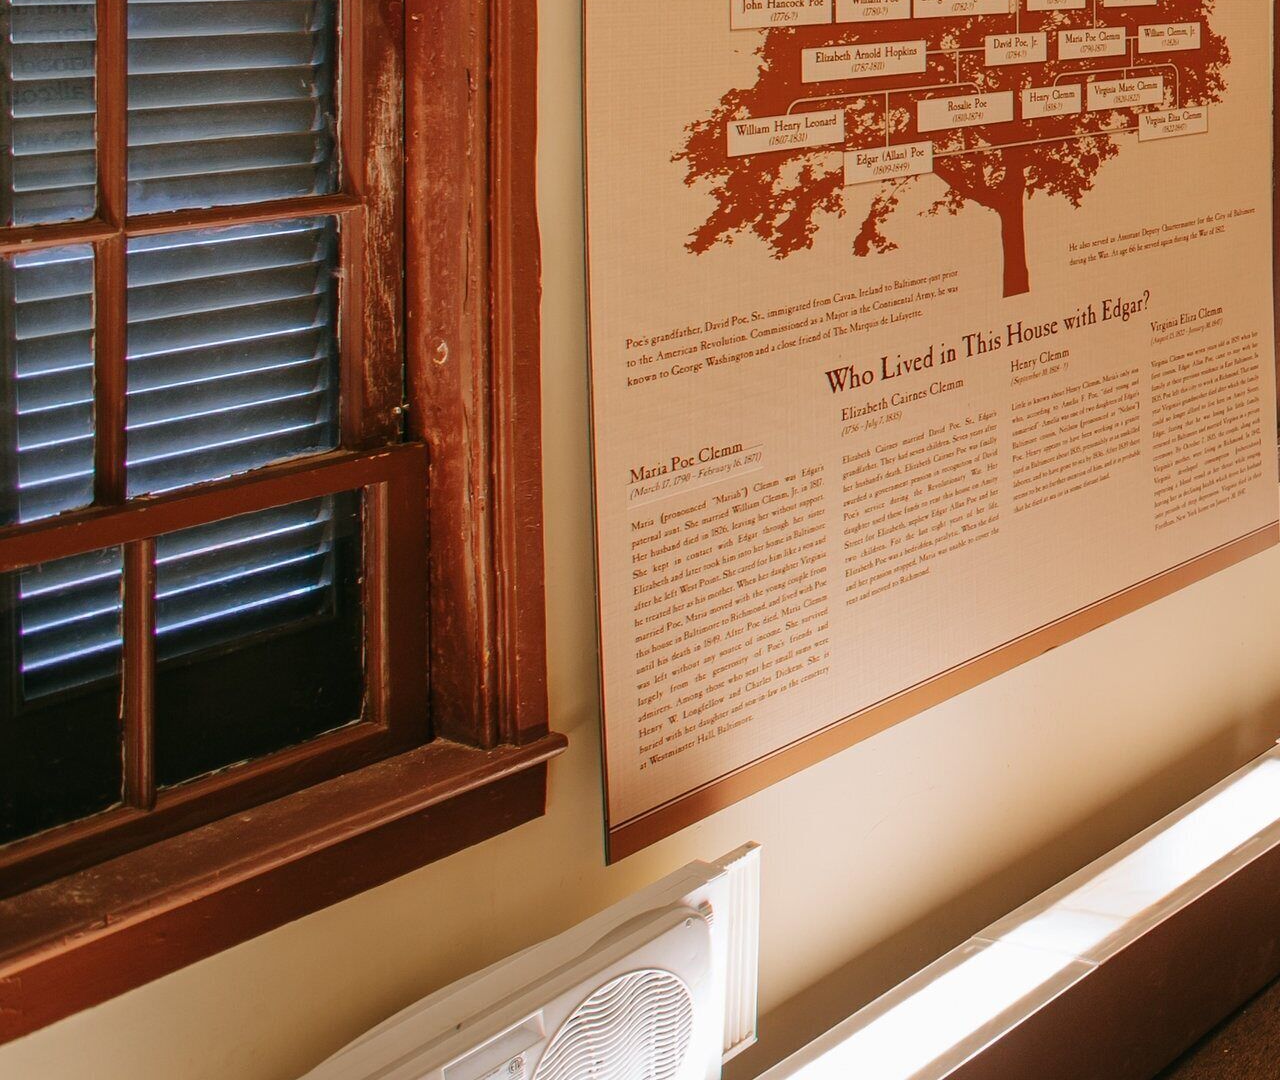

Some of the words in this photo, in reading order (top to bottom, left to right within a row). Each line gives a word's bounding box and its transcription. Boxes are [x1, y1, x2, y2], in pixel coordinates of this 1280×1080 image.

[815, 49, 851, 64] Elizabeth
[853, 48, 882, 60] Arnold
[884, 46, 918, 61] Hopkins
[856, 153, 879, 168] Edgar
[881, 149, 908, 163] (Allan)
[910, 147, 925, 159] Poe
[1149, 314, 1178, 334] Virginia
[1178, 311, 1197, 327] Eliza
[1197, 304, 1224, 321] Clemm
[824, 364, 875, 395] Who
[880, 344, 934, 381] Lived
[939, 342, 957, 366] in
[961, 329, 1002, 358] This
[1005, 318, 1060, 350] House
[1062, 305, 1098, 332] with
[1100, 289, 1152, 324] Edgar?
[1009, 354, 1037, 374] Henry
[1039, 347, 1071, 365] Clemm
[841, 397, 889, 422] Elizabeth
[890, 389, 928, 408] Cairnes
[929, 378, 965, 396] Clemm
[629, 460, 669, 485] Maria
[671, 454, 695, 473] Poe
[697, 439, 744, 465] Clemm
